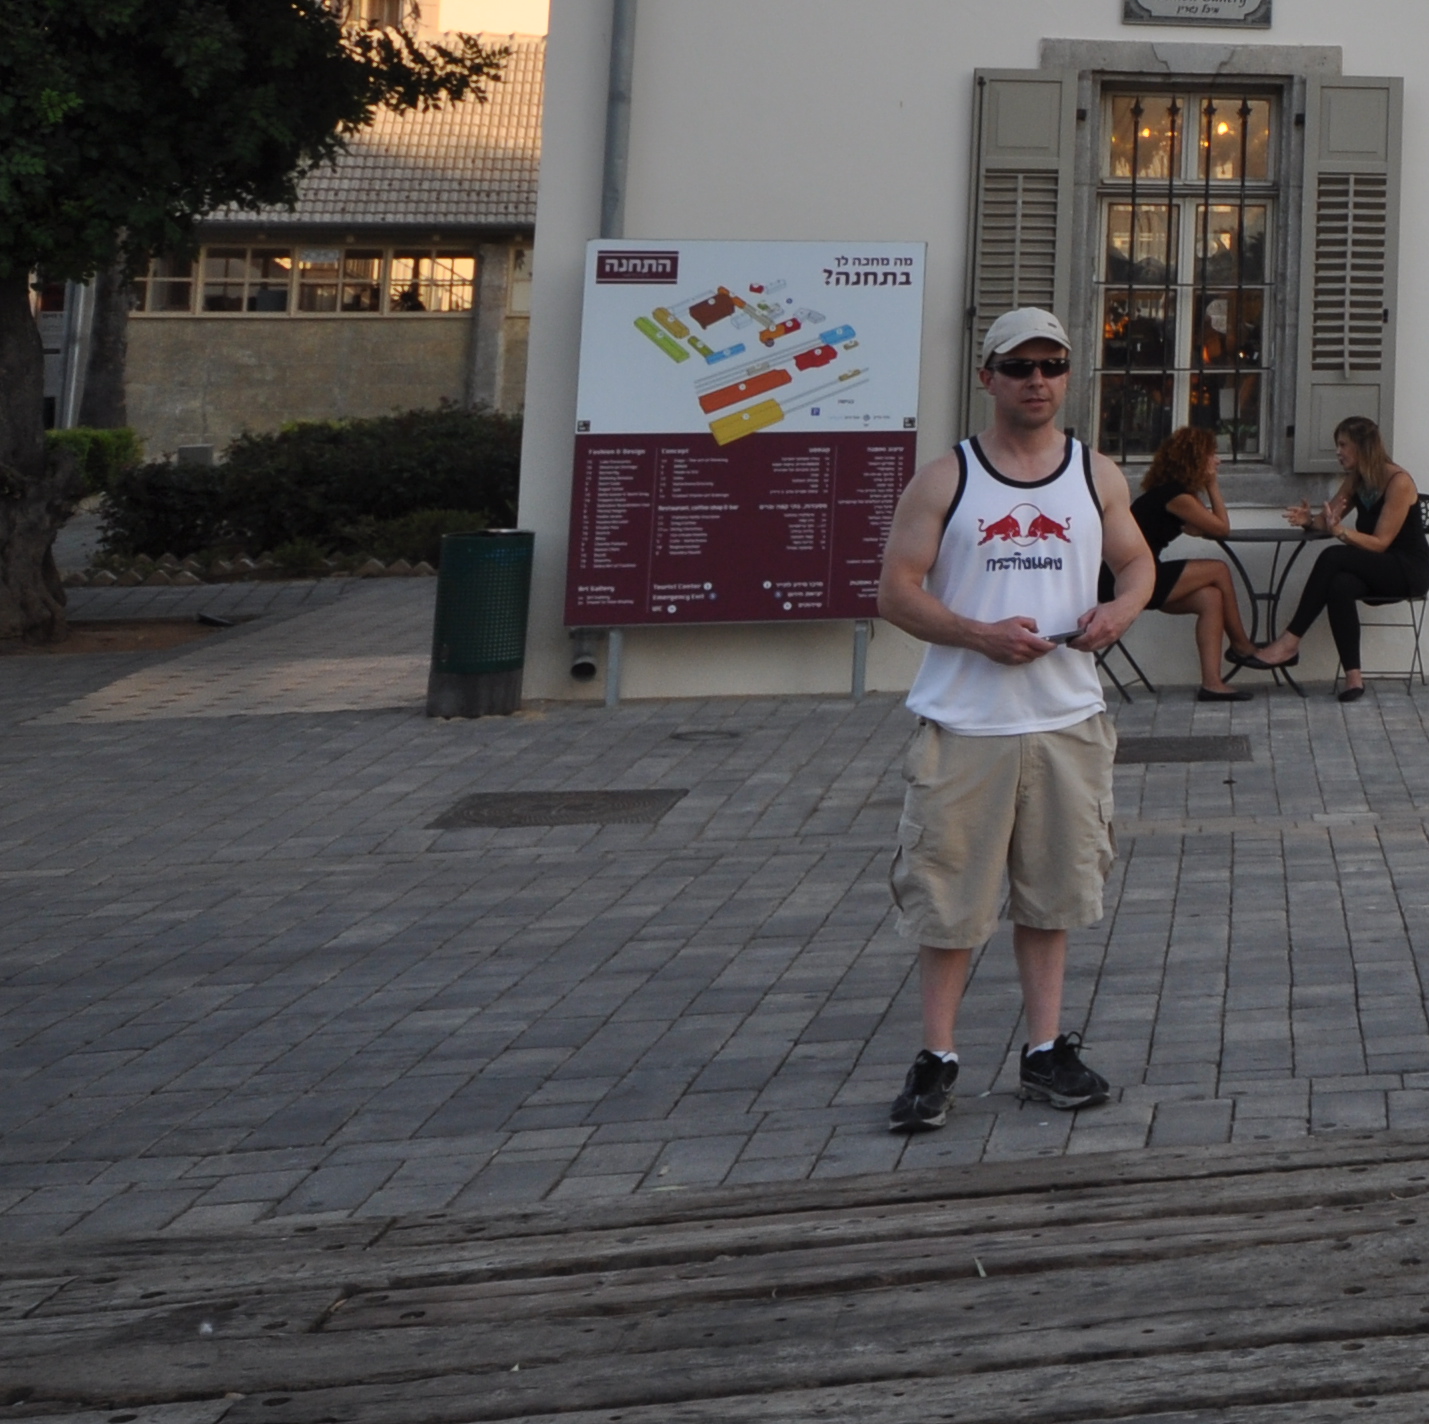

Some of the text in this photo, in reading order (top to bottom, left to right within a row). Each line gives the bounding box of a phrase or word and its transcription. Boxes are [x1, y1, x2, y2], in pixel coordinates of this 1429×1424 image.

[604, 258, 672, 274] התחנה
[834, 255, 914, 268] מה מחכה לך
[822, 268, 912, 287] בתחנה?
